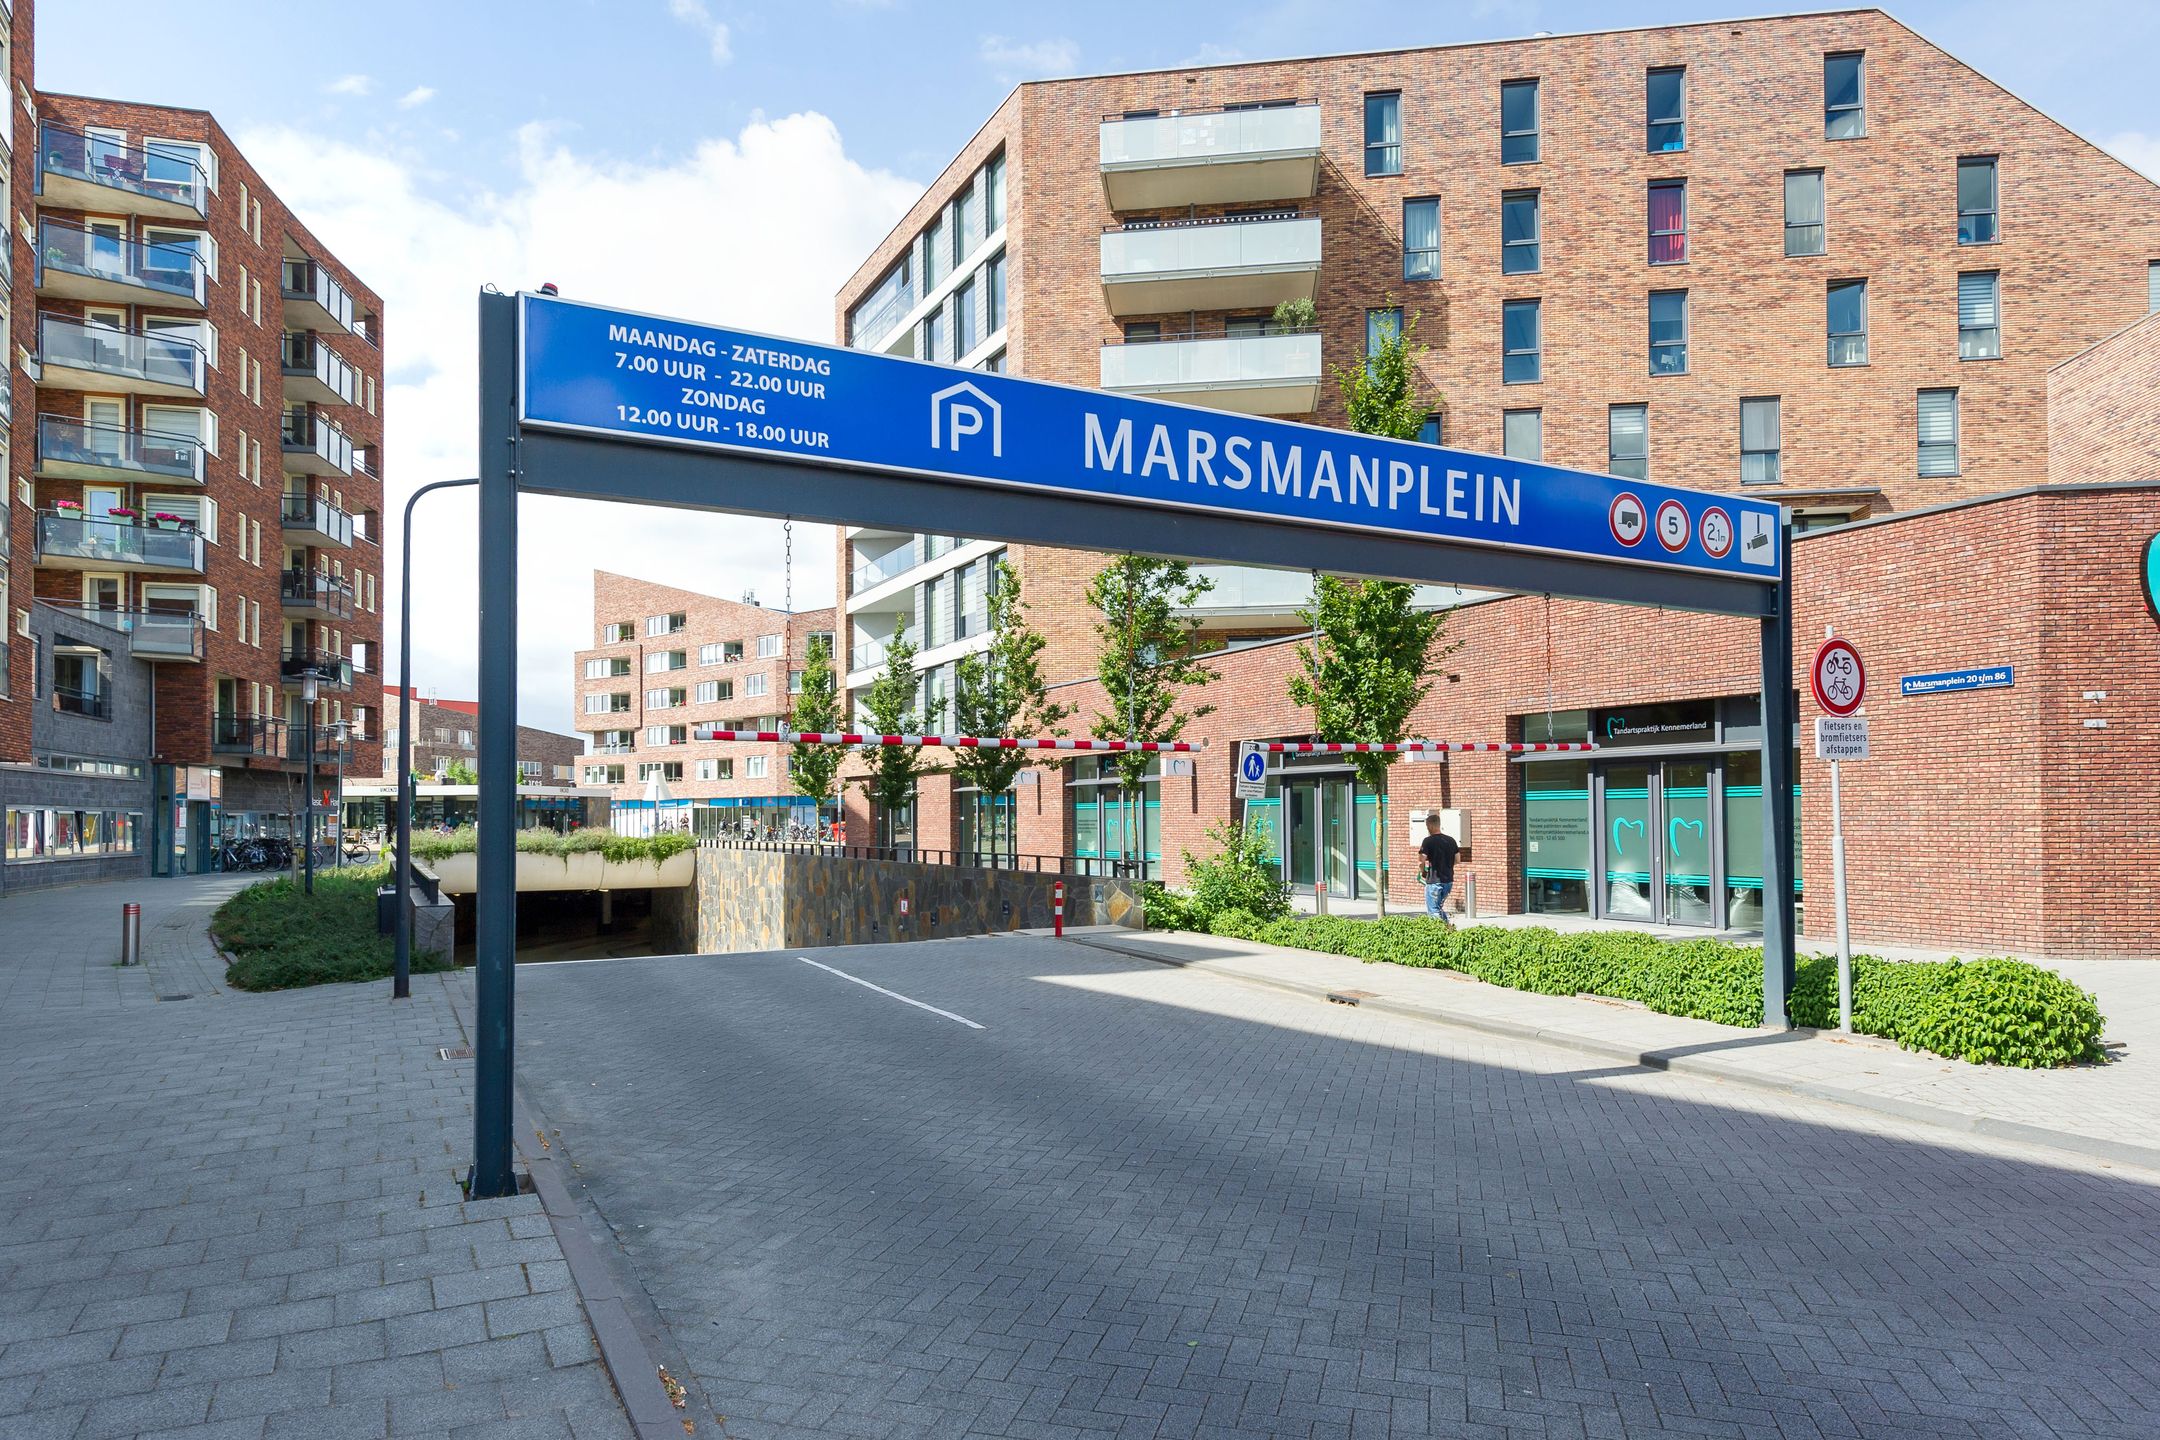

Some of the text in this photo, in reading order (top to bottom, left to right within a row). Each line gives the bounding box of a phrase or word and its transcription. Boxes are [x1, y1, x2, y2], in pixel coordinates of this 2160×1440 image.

[609, 324, 716, 357] MAANDAG
[731, 344, 831, 376] ZATERDAG
[615, 351, 659, 375] 7.00
[663, 355, 706, 381] UUR
[730, 370, 782, 393] 22.00
[786, 378, 825, 400] UUR
[681, 387, 766, 415] ZONDAG
[616, 404, 672, 427] 12.00
[676, 412, 719, 434] UUR
[735, 421, 786, 443] 18.00
[790, 428, 829, 449] UUR
[1084, 411, 1521, 526] MARSMANPLEIN
[1668, 516, 1678, 535] 5
[1912, 671, 2006, 688] Marsmanplein 20 t/m 86
[1613, 721, 1707, 735] Tandartspraktijk Kennemerland
[1824, 721, 1862, 731] fietsers en
[1820, 732, 1867, 742] bromfietsers
[1826, 744, 1863, 756] afstappen
